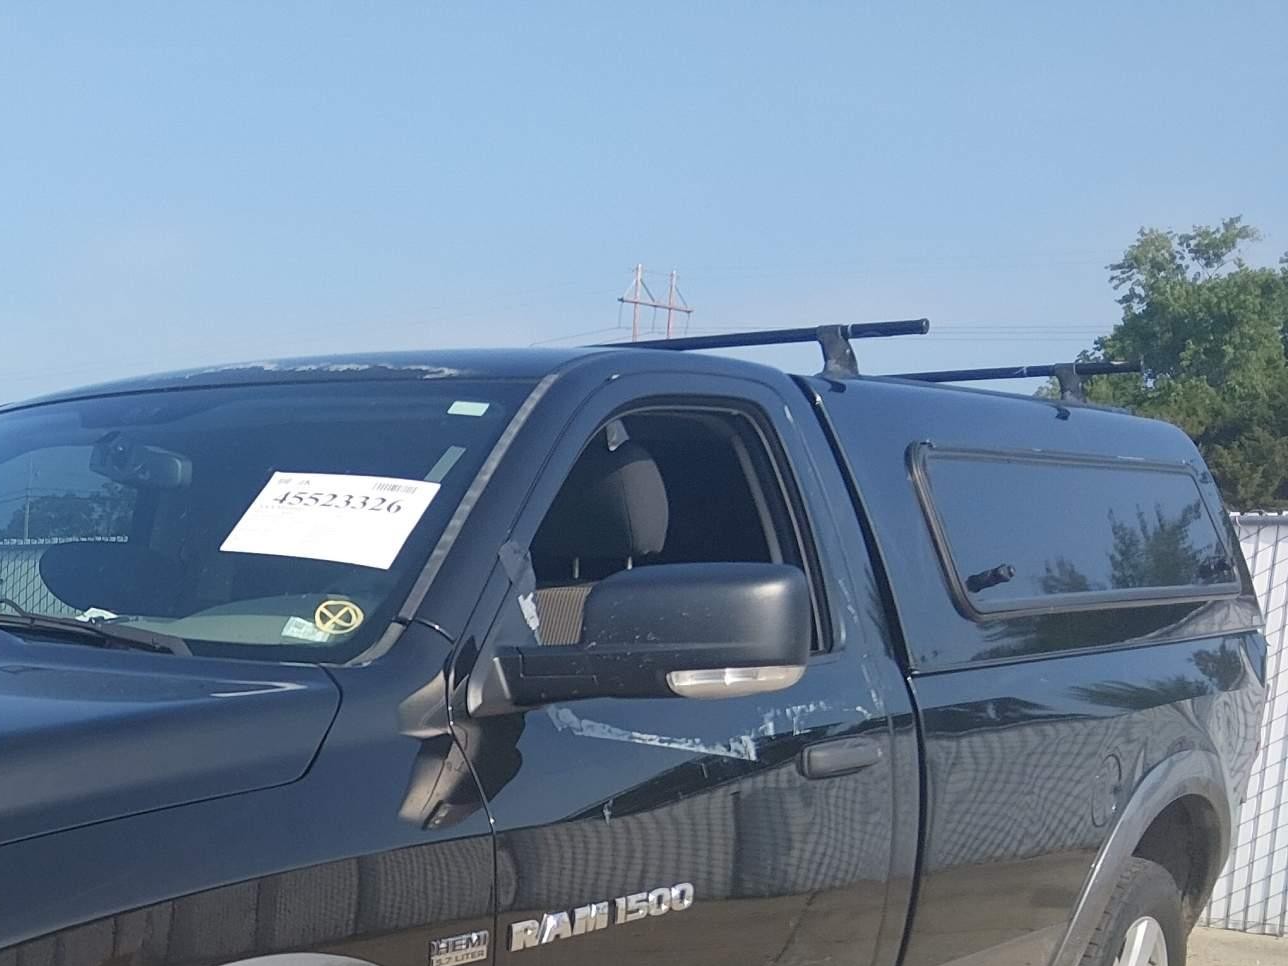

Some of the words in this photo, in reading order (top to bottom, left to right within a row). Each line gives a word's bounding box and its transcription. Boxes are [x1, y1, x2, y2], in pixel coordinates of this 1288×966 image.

[273, 491, 405, 514] 45523326
[510, 901, 609, 952] RAM
[615, 882, 694, 925] 1500
[438, 930, 489, 954] HEMI
